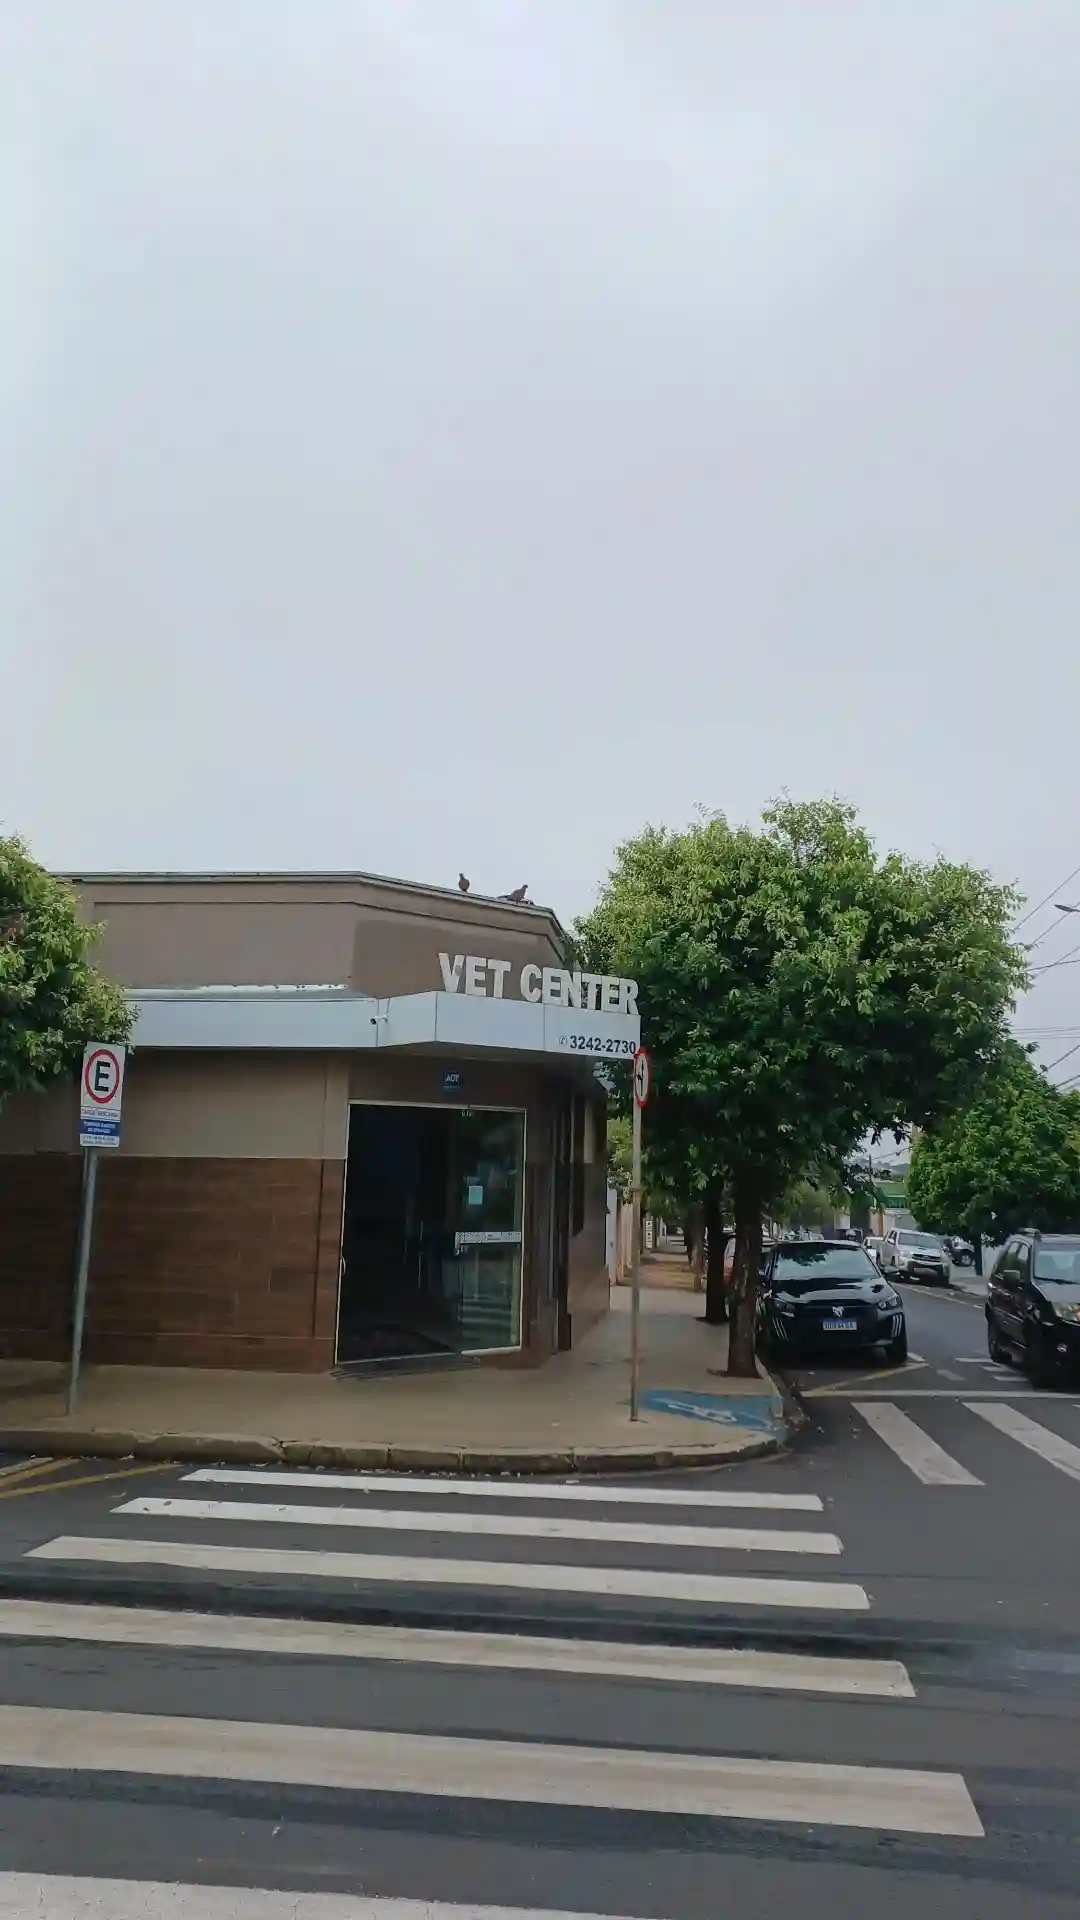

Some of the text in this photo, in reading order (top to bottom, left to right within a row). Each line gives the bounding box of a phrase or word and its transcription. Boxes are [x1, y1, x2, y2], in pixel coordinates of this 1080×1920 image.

[438, 952, 639, 1015] VET CENTER
[569, 1035, 636, 1055] 3242-2730
[94, 1060, 111, 1092] E
